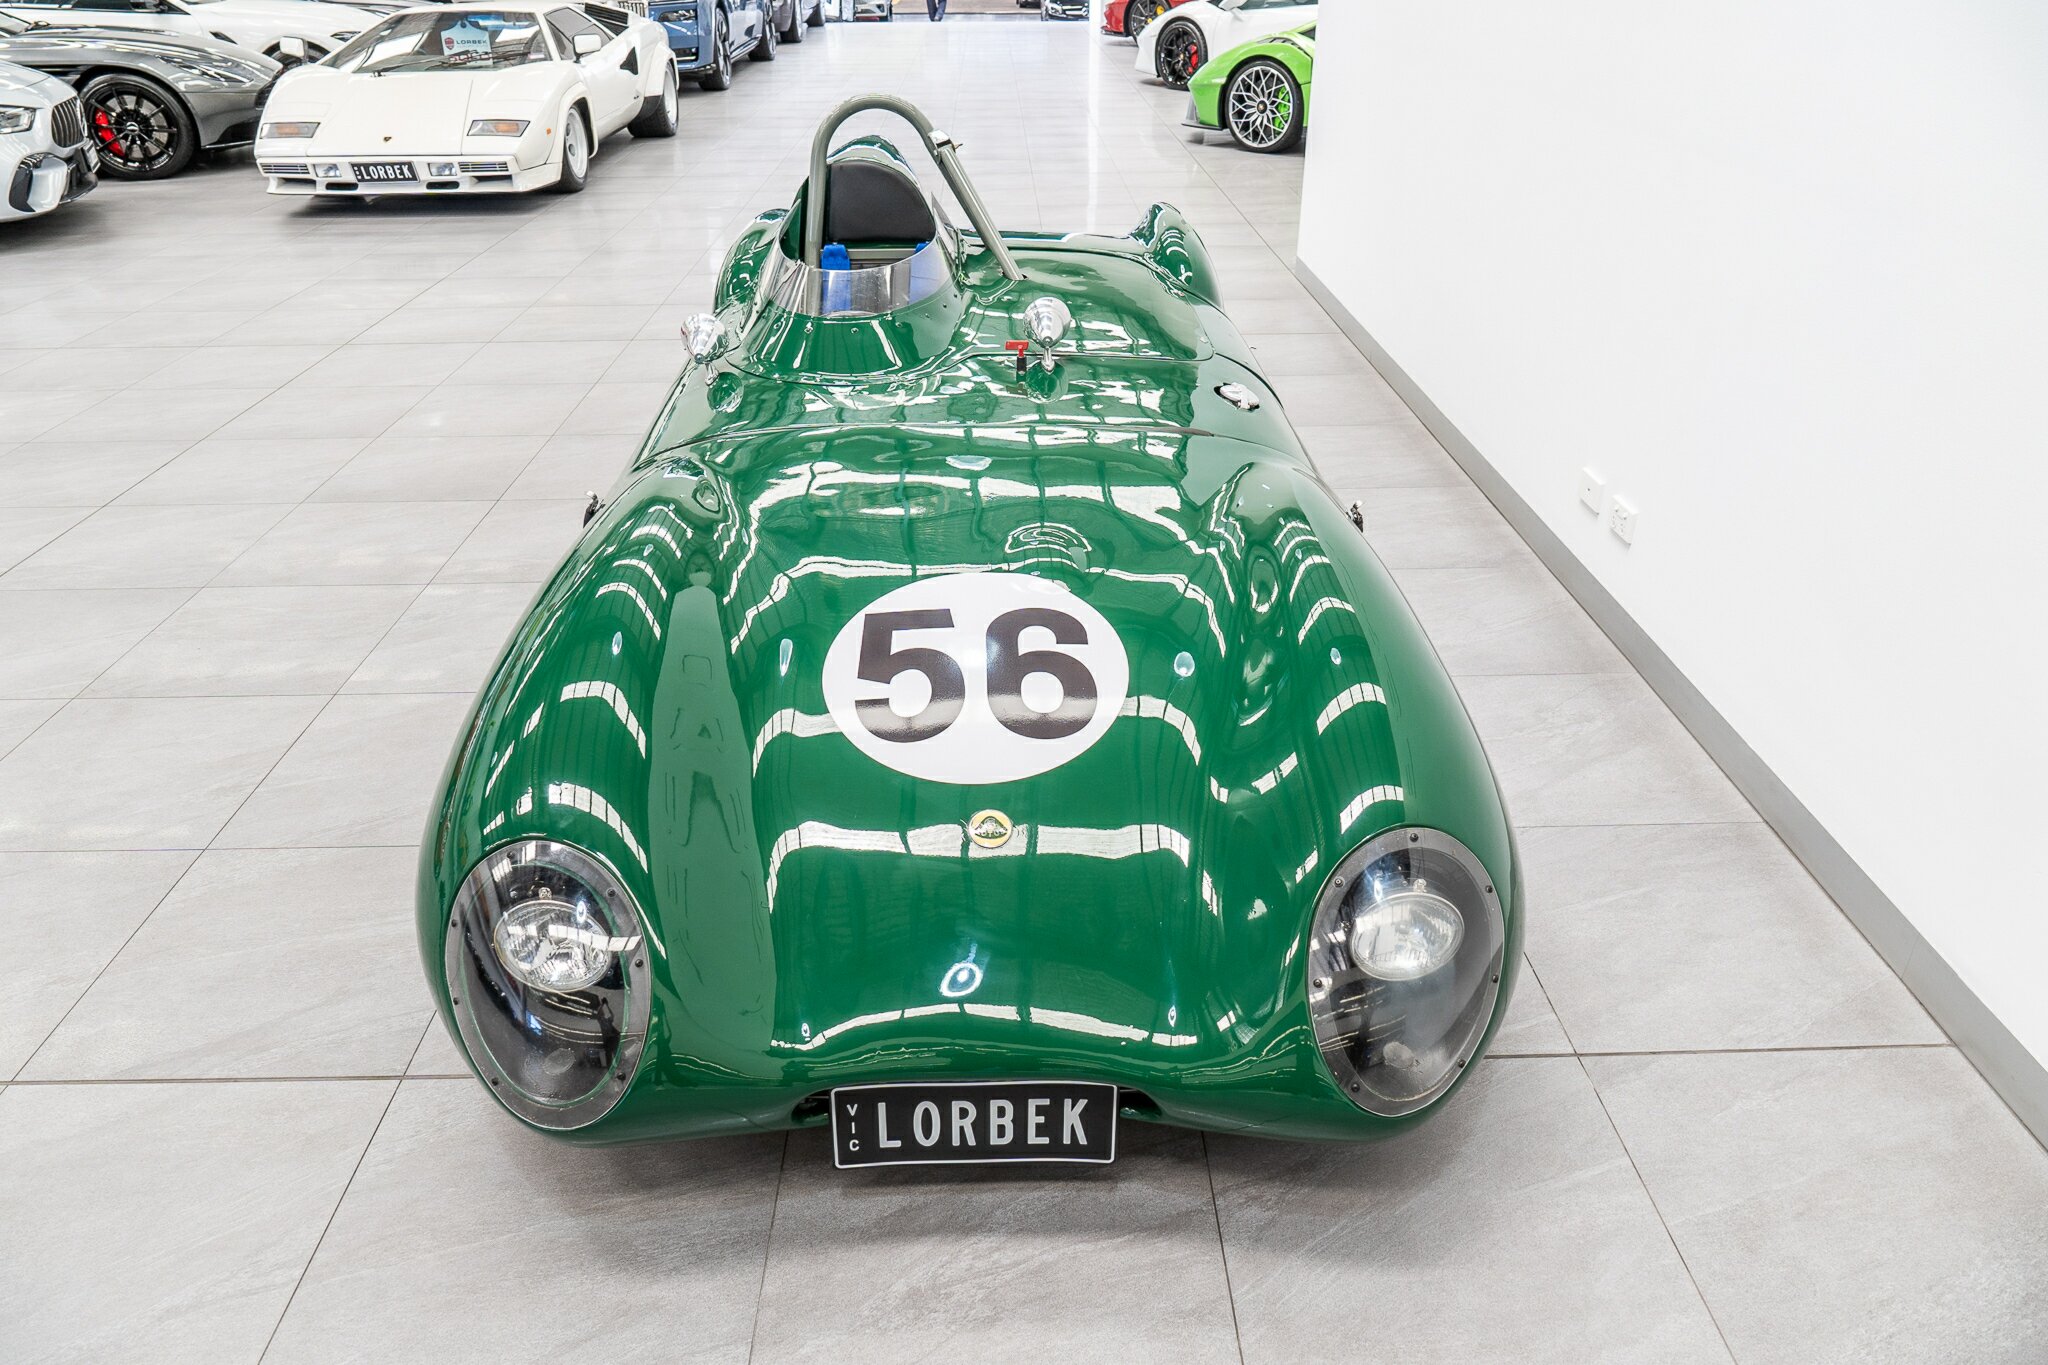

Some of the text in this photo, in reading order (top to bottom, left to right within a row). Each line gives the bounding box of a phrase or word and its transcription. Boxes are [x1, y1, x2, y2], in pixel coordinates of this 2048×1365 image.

[360, 164, 413, 179] LORBEK
[854, 607, 1098, 743] 56
[846, 1103, 860, 1151] VIC
[877, 1098, 1089, 1149] LORBEK
